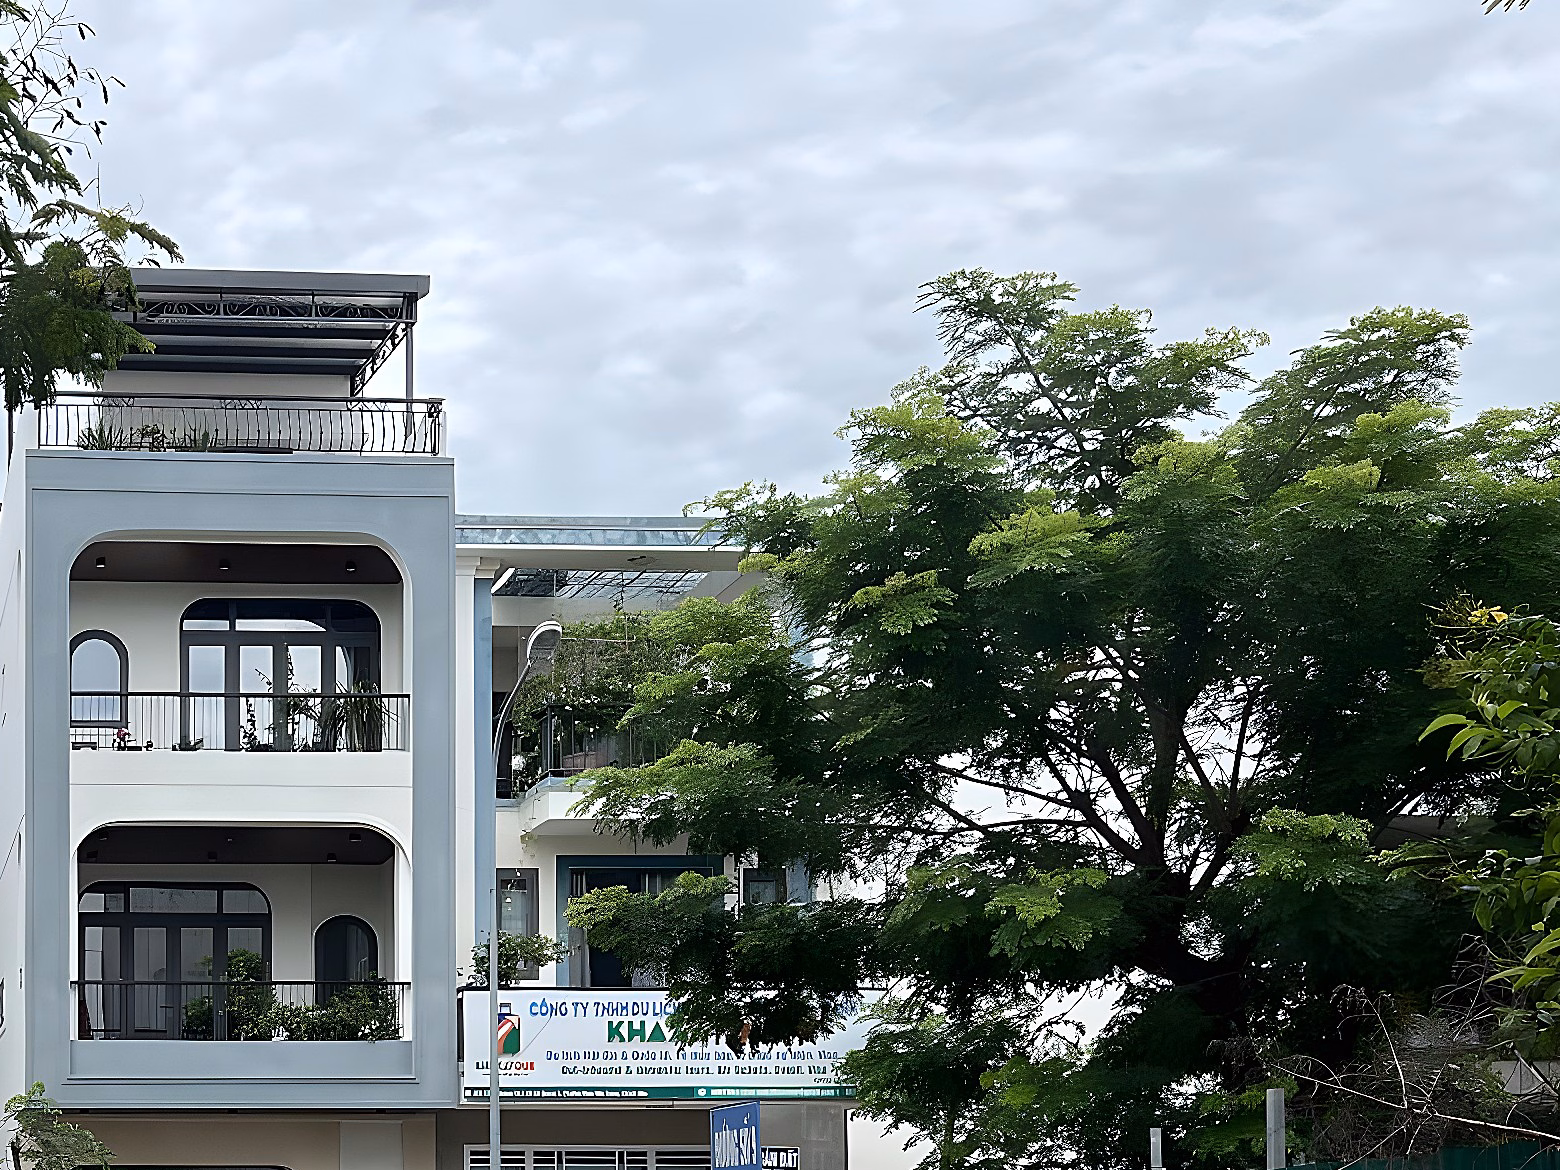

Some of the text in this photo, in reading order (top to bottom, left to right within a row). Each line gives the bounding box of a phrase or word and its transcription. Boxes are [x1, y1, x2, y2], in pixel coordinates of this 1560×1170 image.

[529, 997, 568, 1017] CÔNG
[571, 1001, 589, 1018] TY
[631, 1002, 650, 1016] DU
